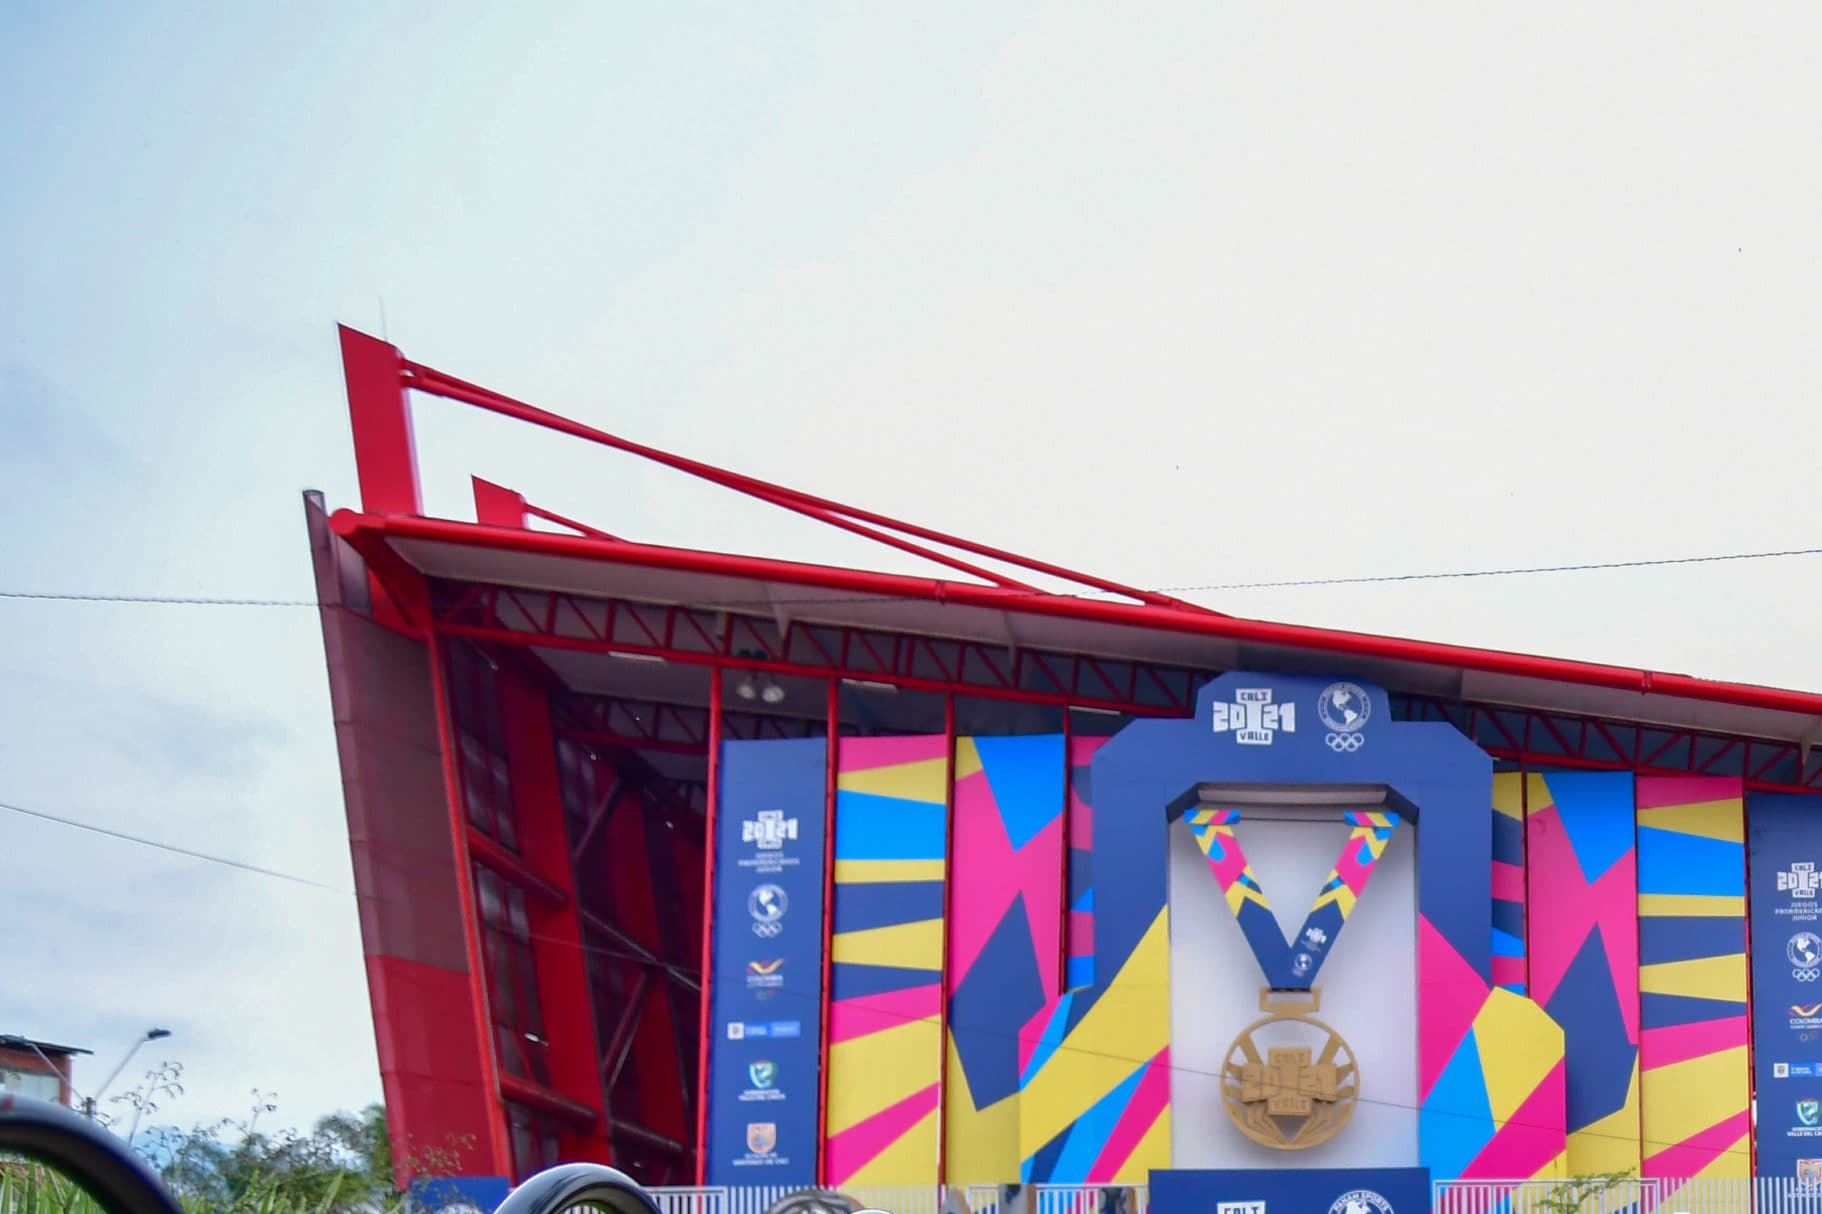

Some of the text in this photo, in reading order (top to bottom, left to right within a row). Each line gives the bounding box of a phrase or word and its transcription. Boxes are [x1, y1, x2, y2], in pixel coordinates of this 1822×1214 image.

[1240, 691, 1268, 702] CALI
[1213, 701, 1296, 733] 2021
[1239, 731, 1270, 741] VALLE
